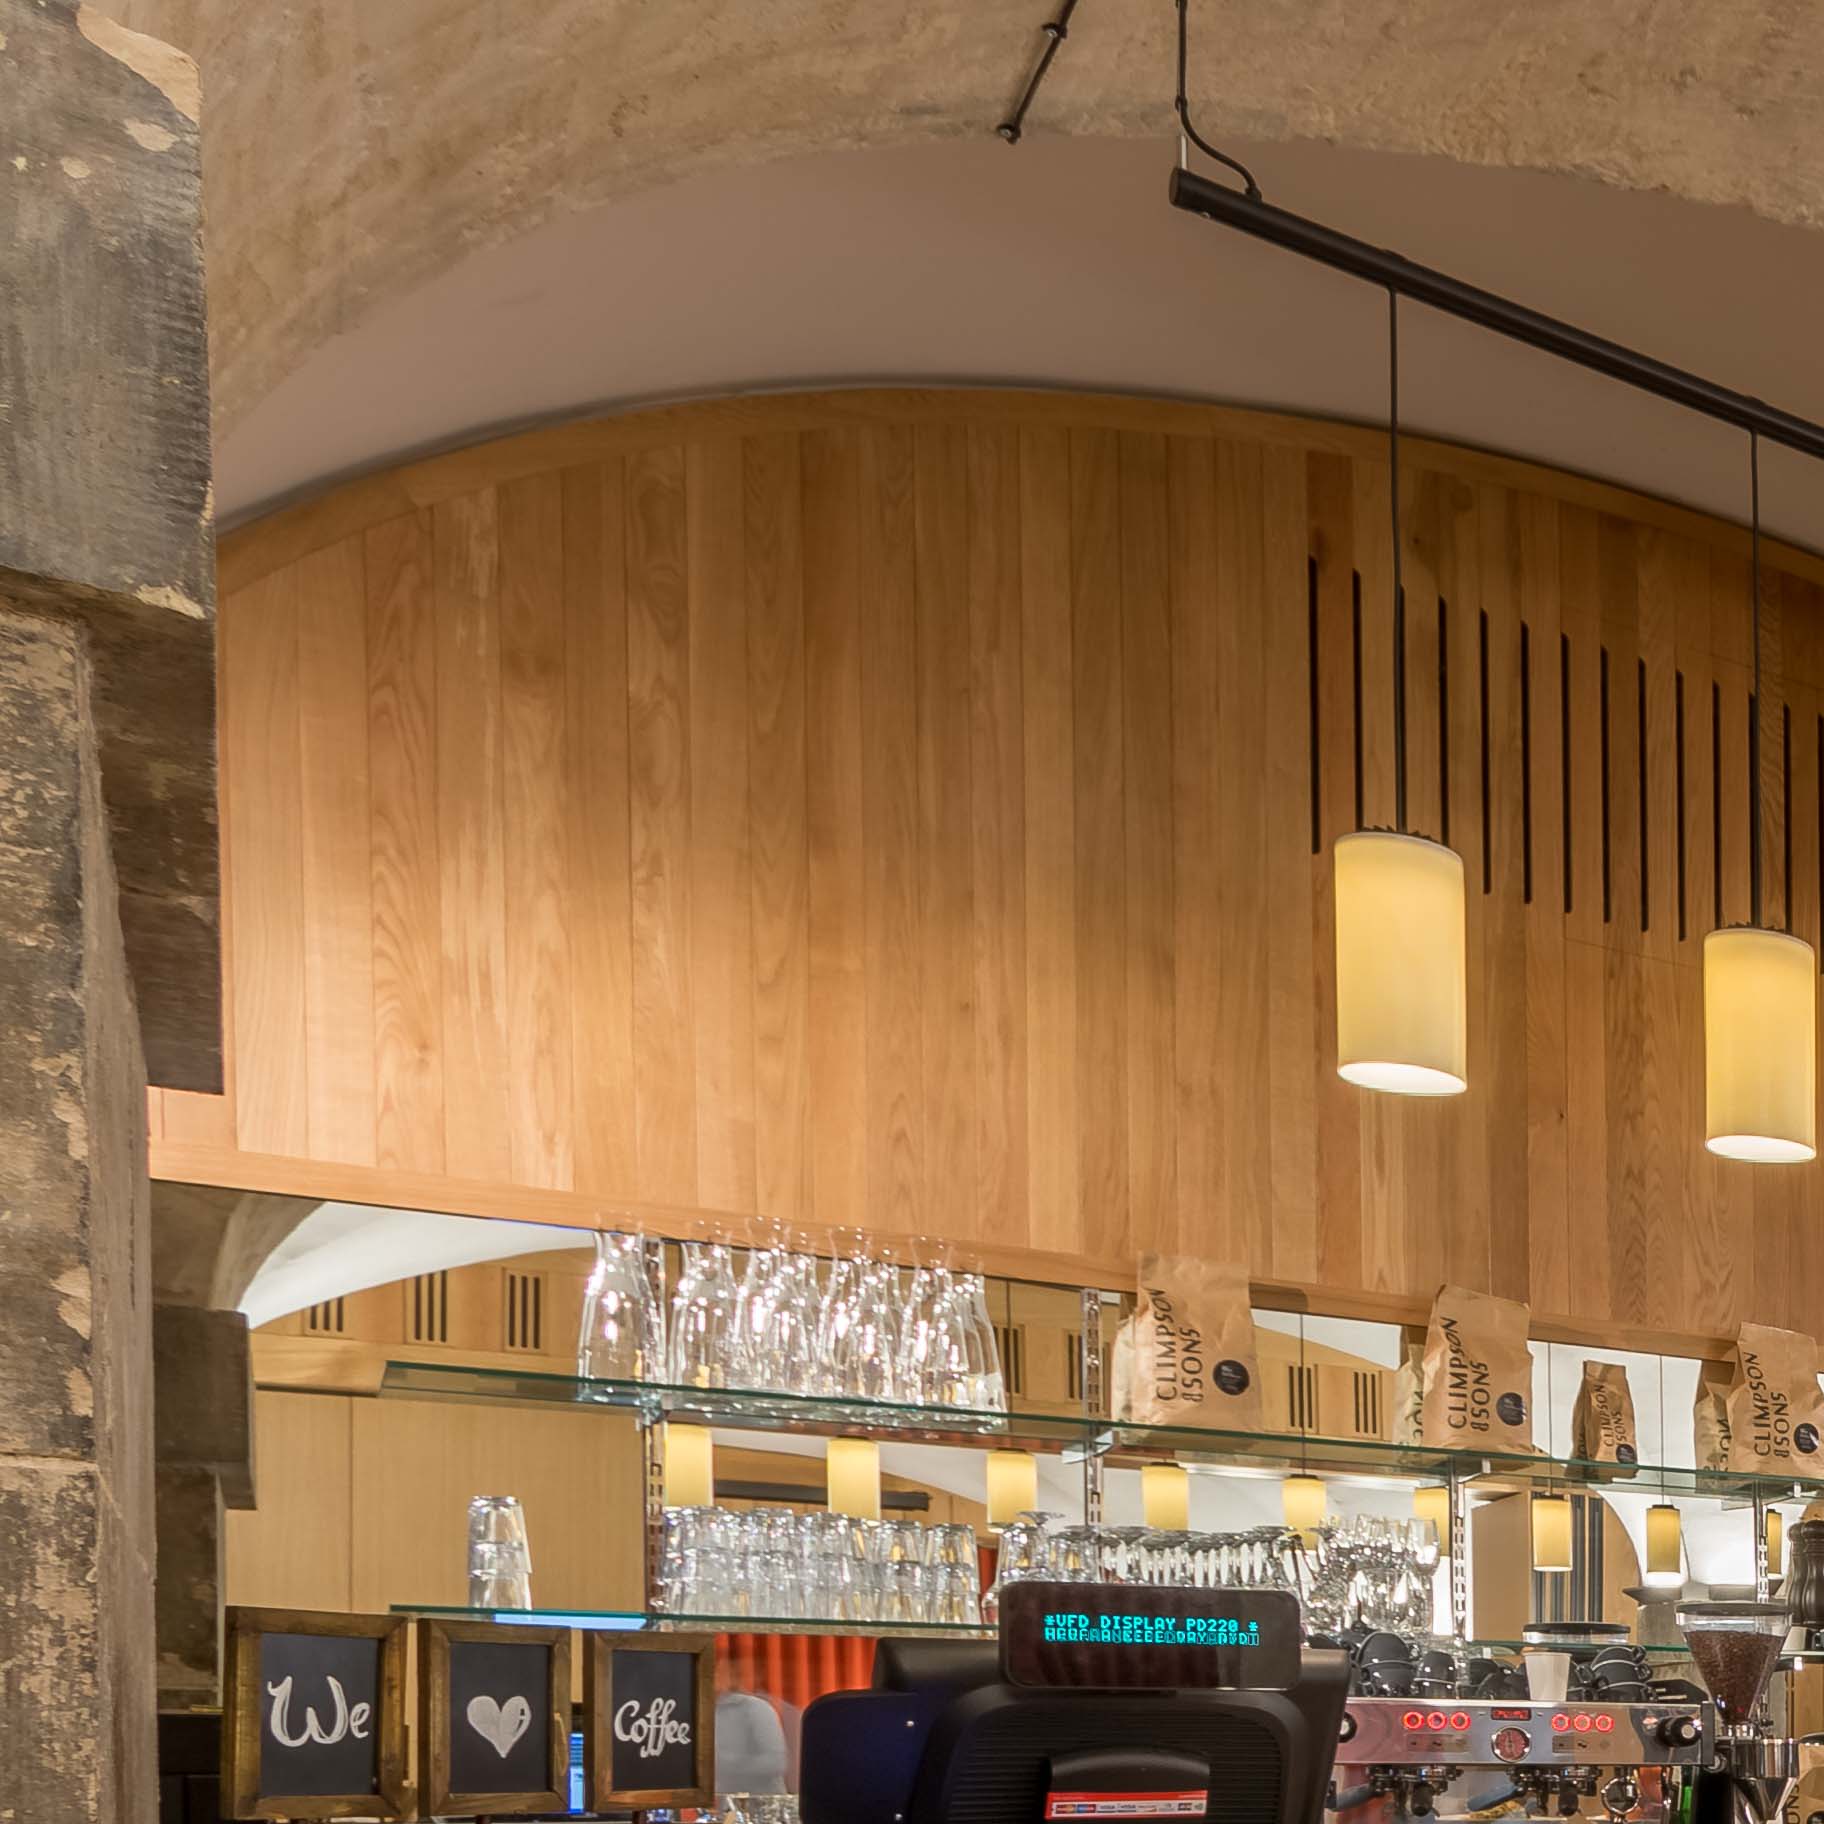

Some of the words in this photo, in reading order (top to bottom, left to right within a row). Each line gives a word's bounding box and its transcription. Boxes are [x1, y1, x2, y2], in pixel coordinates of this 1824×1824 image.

[1148, 1288, 1178, 1401] CLIMPSON
[1440, 1316, 1468, 1429] CLIMPSON
[1744, 1352, 1771, 1456] CLIMPSON
[1100, 1615, 1176, 1631] DISPLAY
[1186, 1618, 1238, 1632] PD220
[267, 1674, 371, 1747] We
[613, 1697, 692, 1759] Coffee
